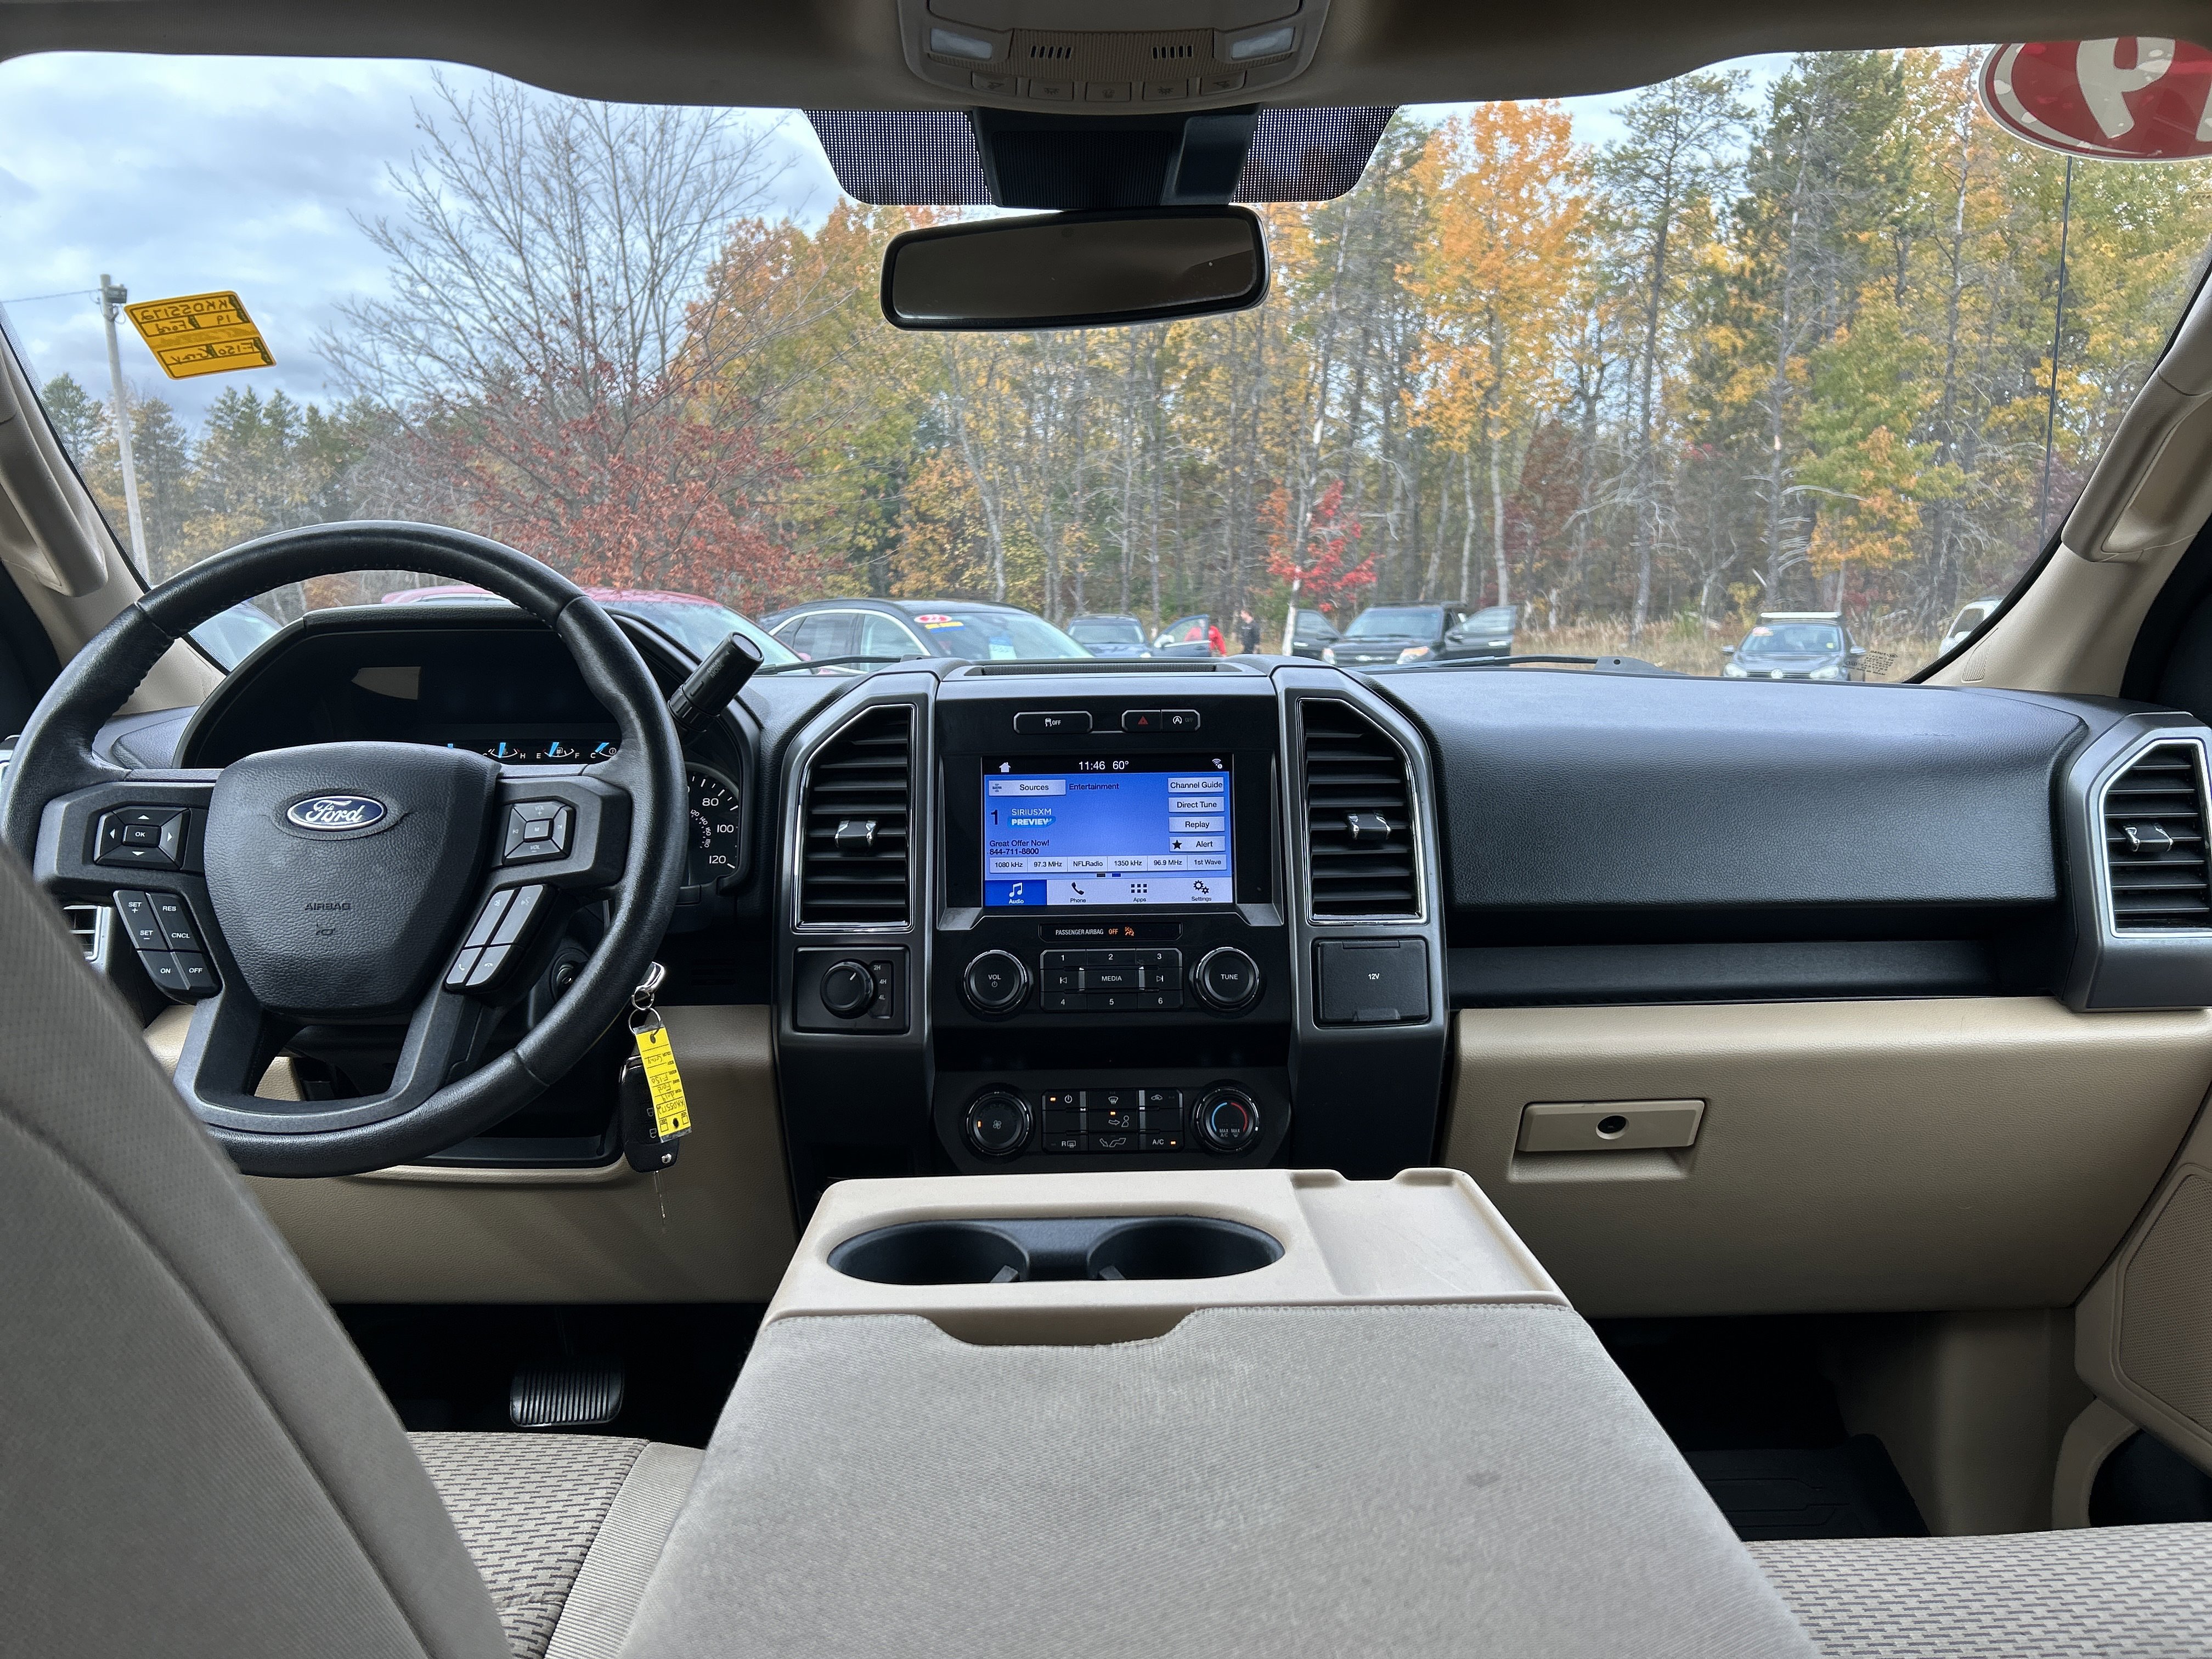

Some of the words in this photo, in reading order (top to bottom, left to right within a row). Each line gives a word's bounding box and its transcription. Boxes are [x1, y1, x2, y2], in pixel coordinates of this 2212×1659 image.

[1079, 761, 1105, 770] 11:46
[702, 798, 719, 806] 80
[306, 799, 365, 822] Ford
[699, 816, 708, 825] 140
[991, 809, 998, 825] 1
[716, 824, 734, 833] 100
[1185, 821, 1210, 829] Replay
[709, 855, 726, 864] 120
[304, 902, 351, 911] AIRBAG
